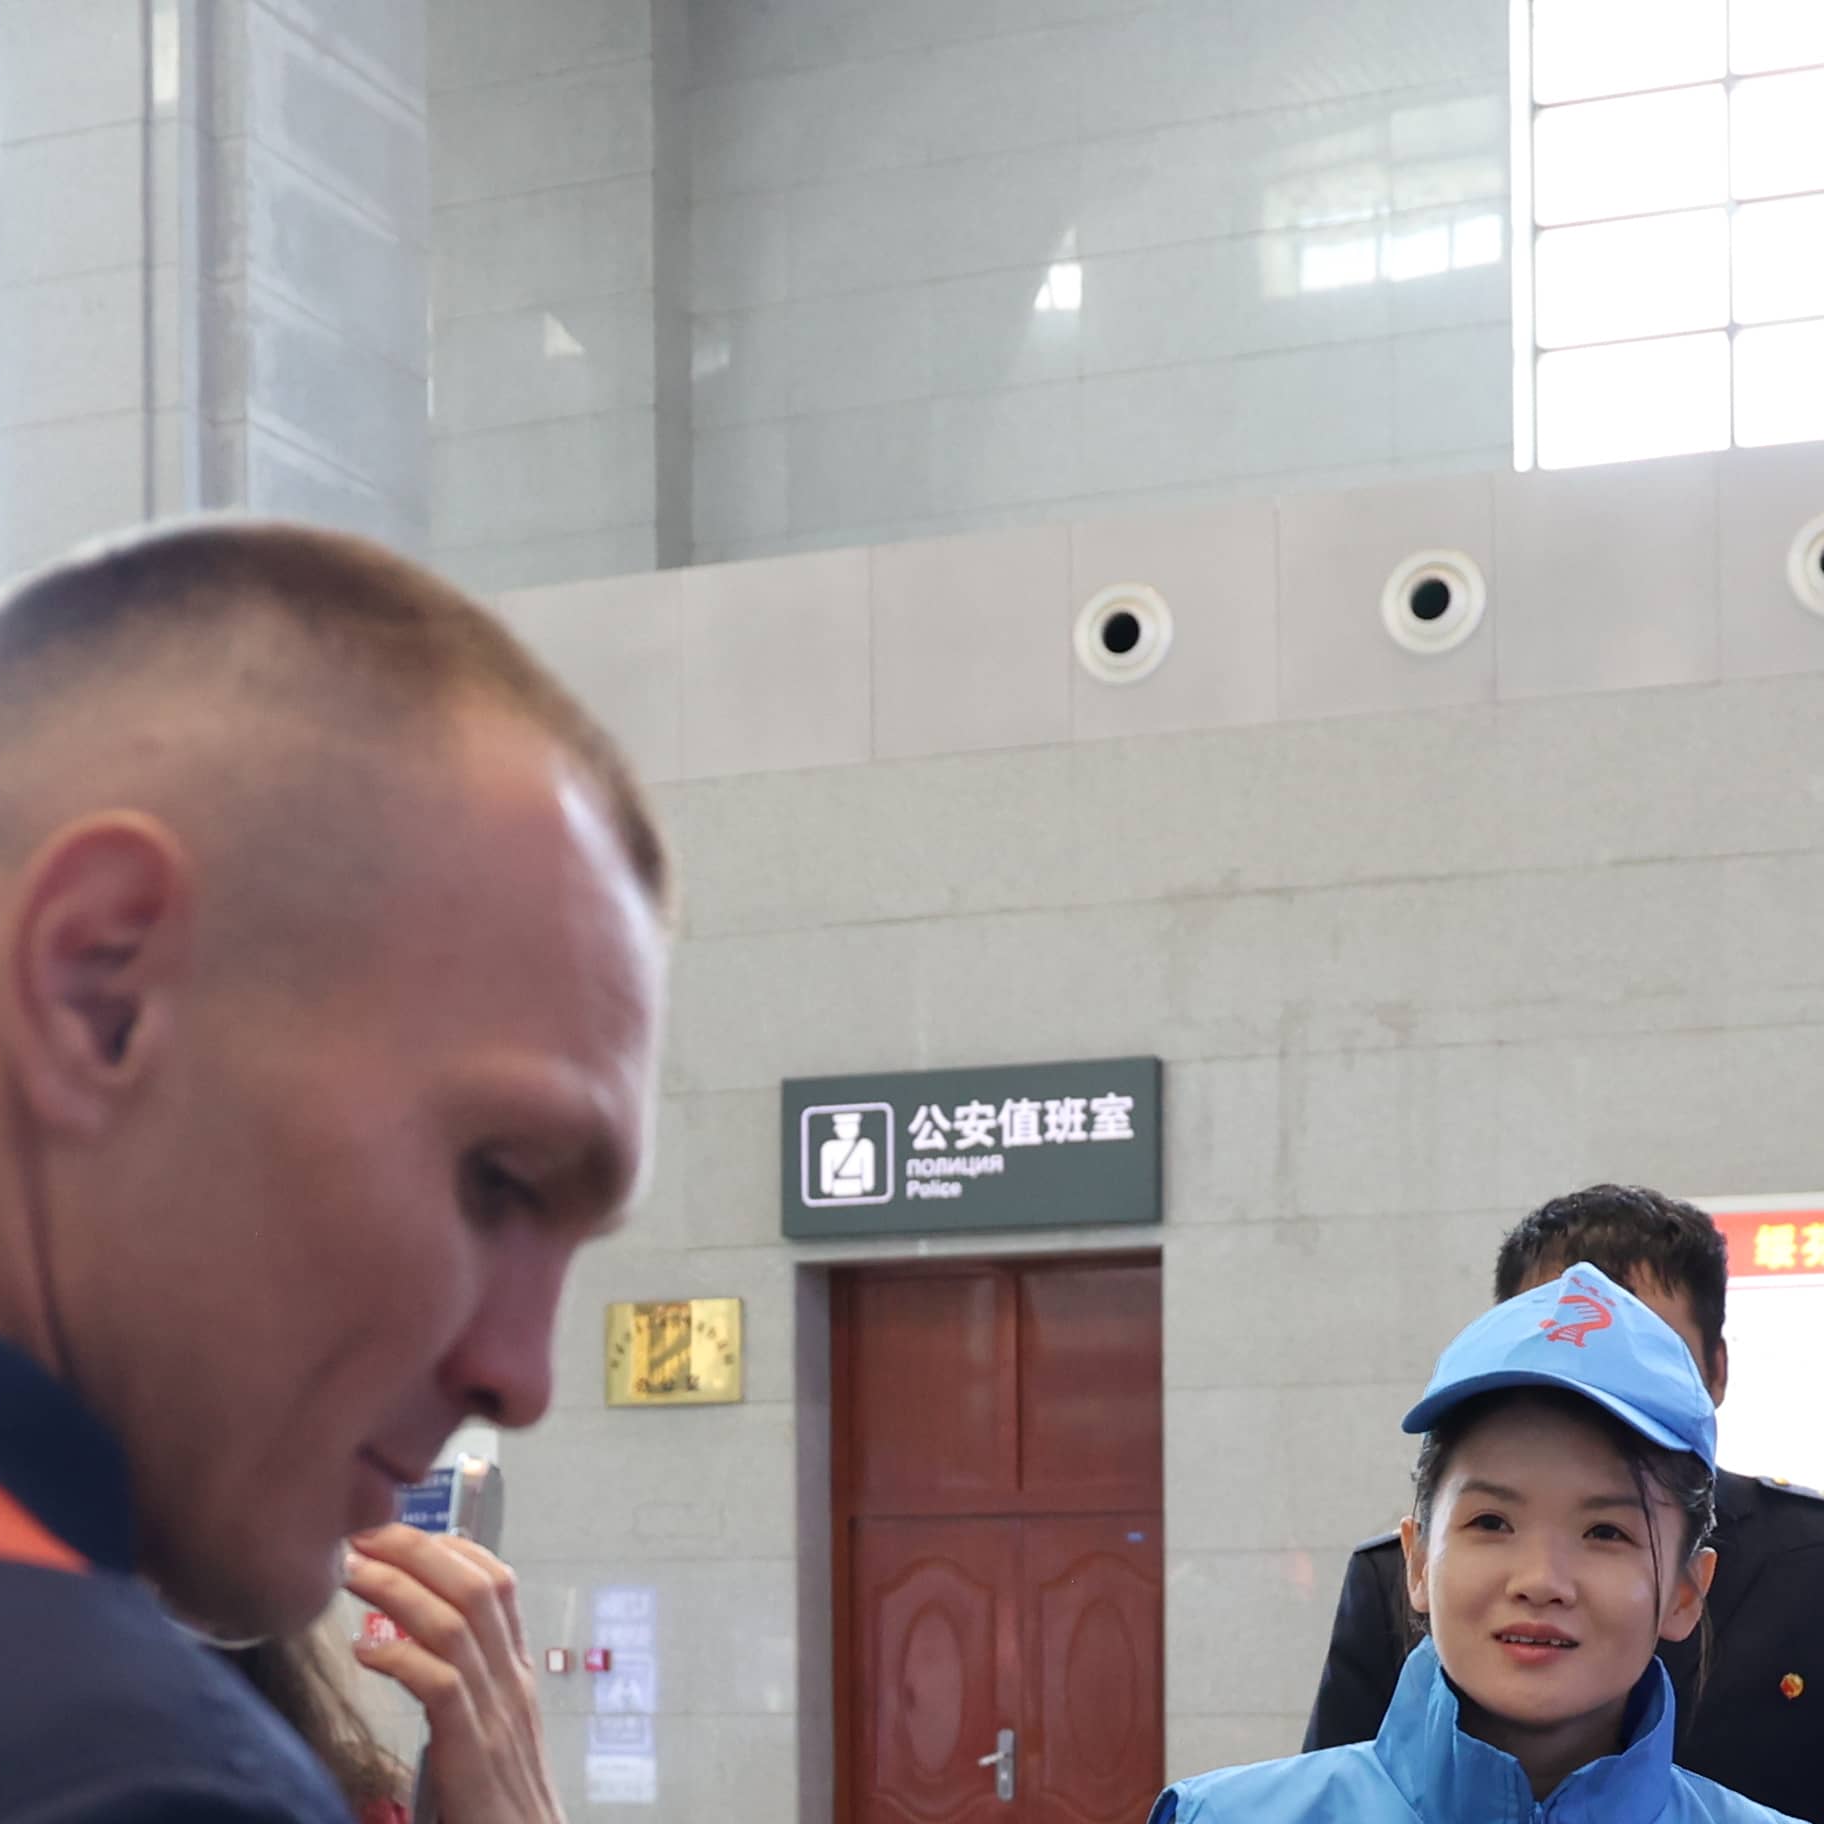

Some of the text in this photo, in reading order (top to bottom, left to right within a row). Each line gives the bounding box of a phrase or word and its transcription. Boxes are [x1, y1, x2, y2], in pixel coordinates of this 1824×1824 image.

[908, 1092, 1134, 1151] 公安值班室
[906, 1179, 963, 1200] Police
